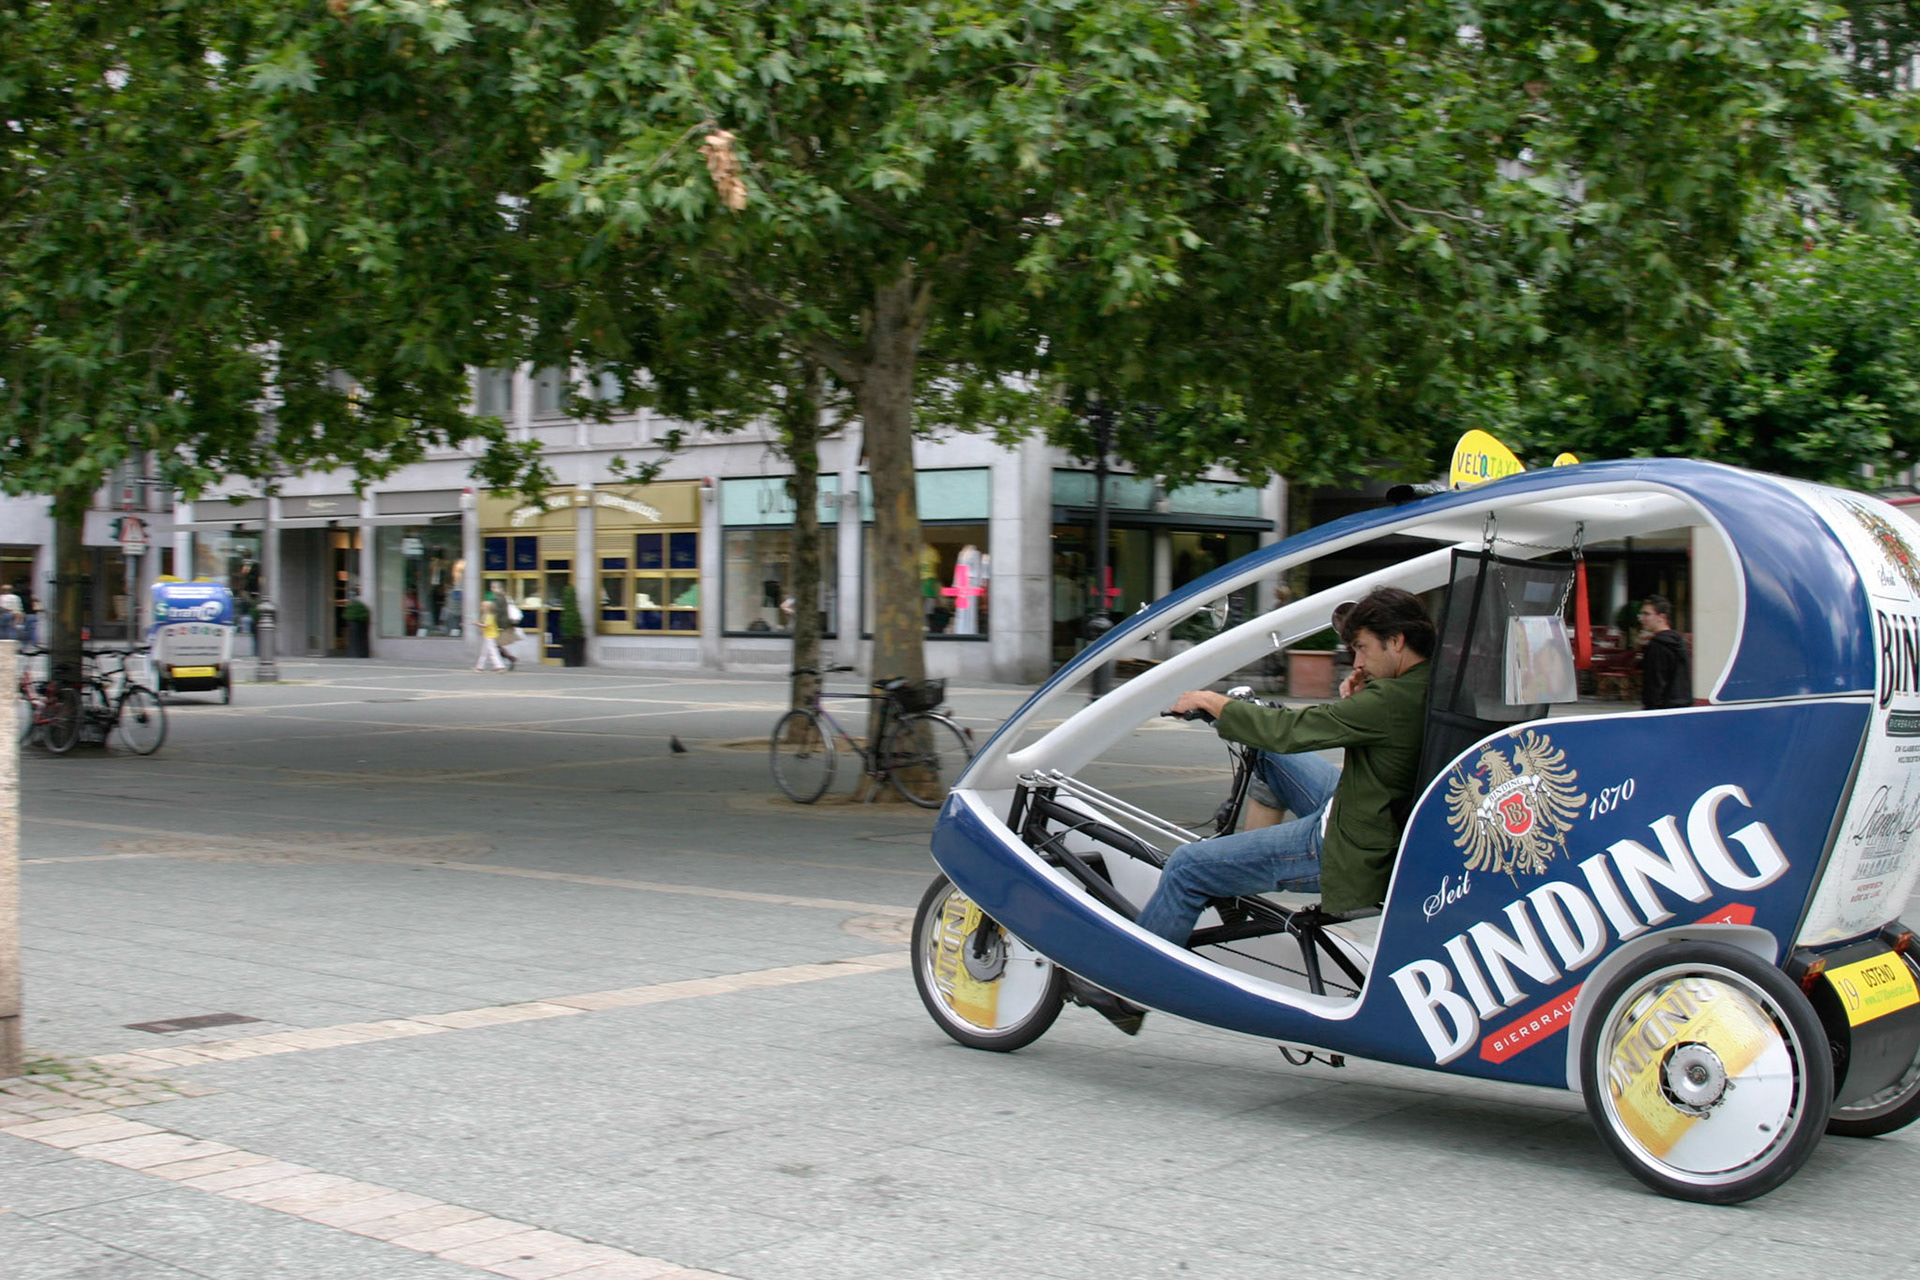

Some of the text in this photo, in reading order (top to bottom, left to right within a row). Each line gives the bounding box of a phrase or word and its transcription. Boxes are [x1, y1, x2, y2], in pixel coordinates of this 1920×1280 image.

[1489, 777, 1524, 802] BINDING
[1422, 778, 1635, 923] Seit 1870
[1387, 784, 1790, 1065] BINDING
[1838, 978, 1860, 1011] 19
[1860, 963, 1896, 988] OSTEND
[1493, 996, 1578, 1052] BIERBRAU
